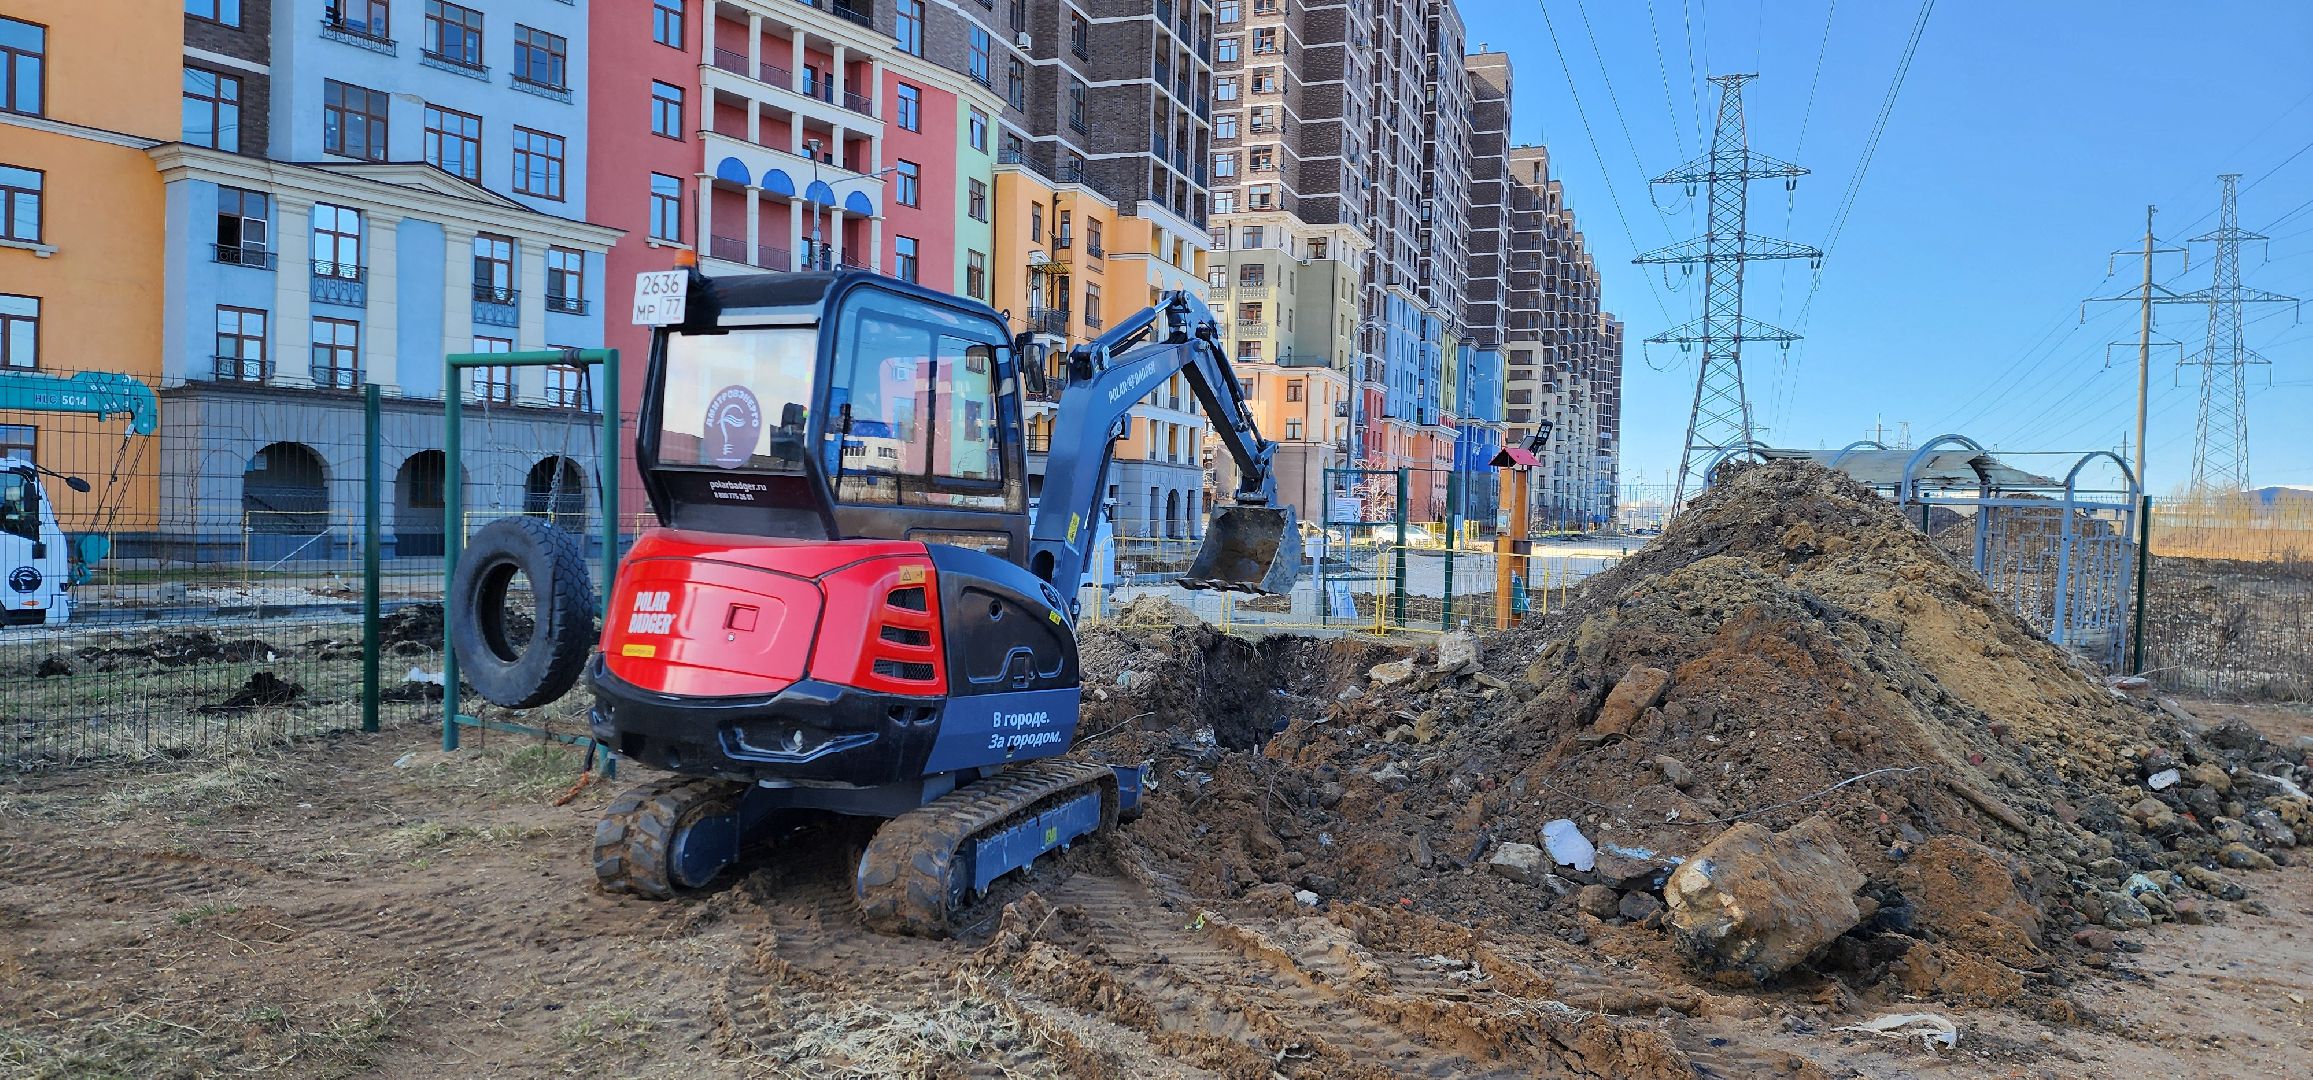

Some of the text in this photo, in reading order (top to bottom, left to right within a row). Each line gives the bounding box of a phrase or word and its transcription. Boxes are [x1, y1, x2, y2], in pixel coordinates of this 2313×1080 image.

[642, 273, 680, 295] 2636
[636, 298, 681, 320] МР 77
[1108, 380, 1128, 404] POLAR
[706, 388, 760, 428] ДМИТРОВЭНЕРГО
[709, 480, 767, 492] polarbadger.ru
[633, 591, 671, 612] POLAR
[993, 711, 1050, 731] В городе.
[988, 731, 1062, 750] За городом.
